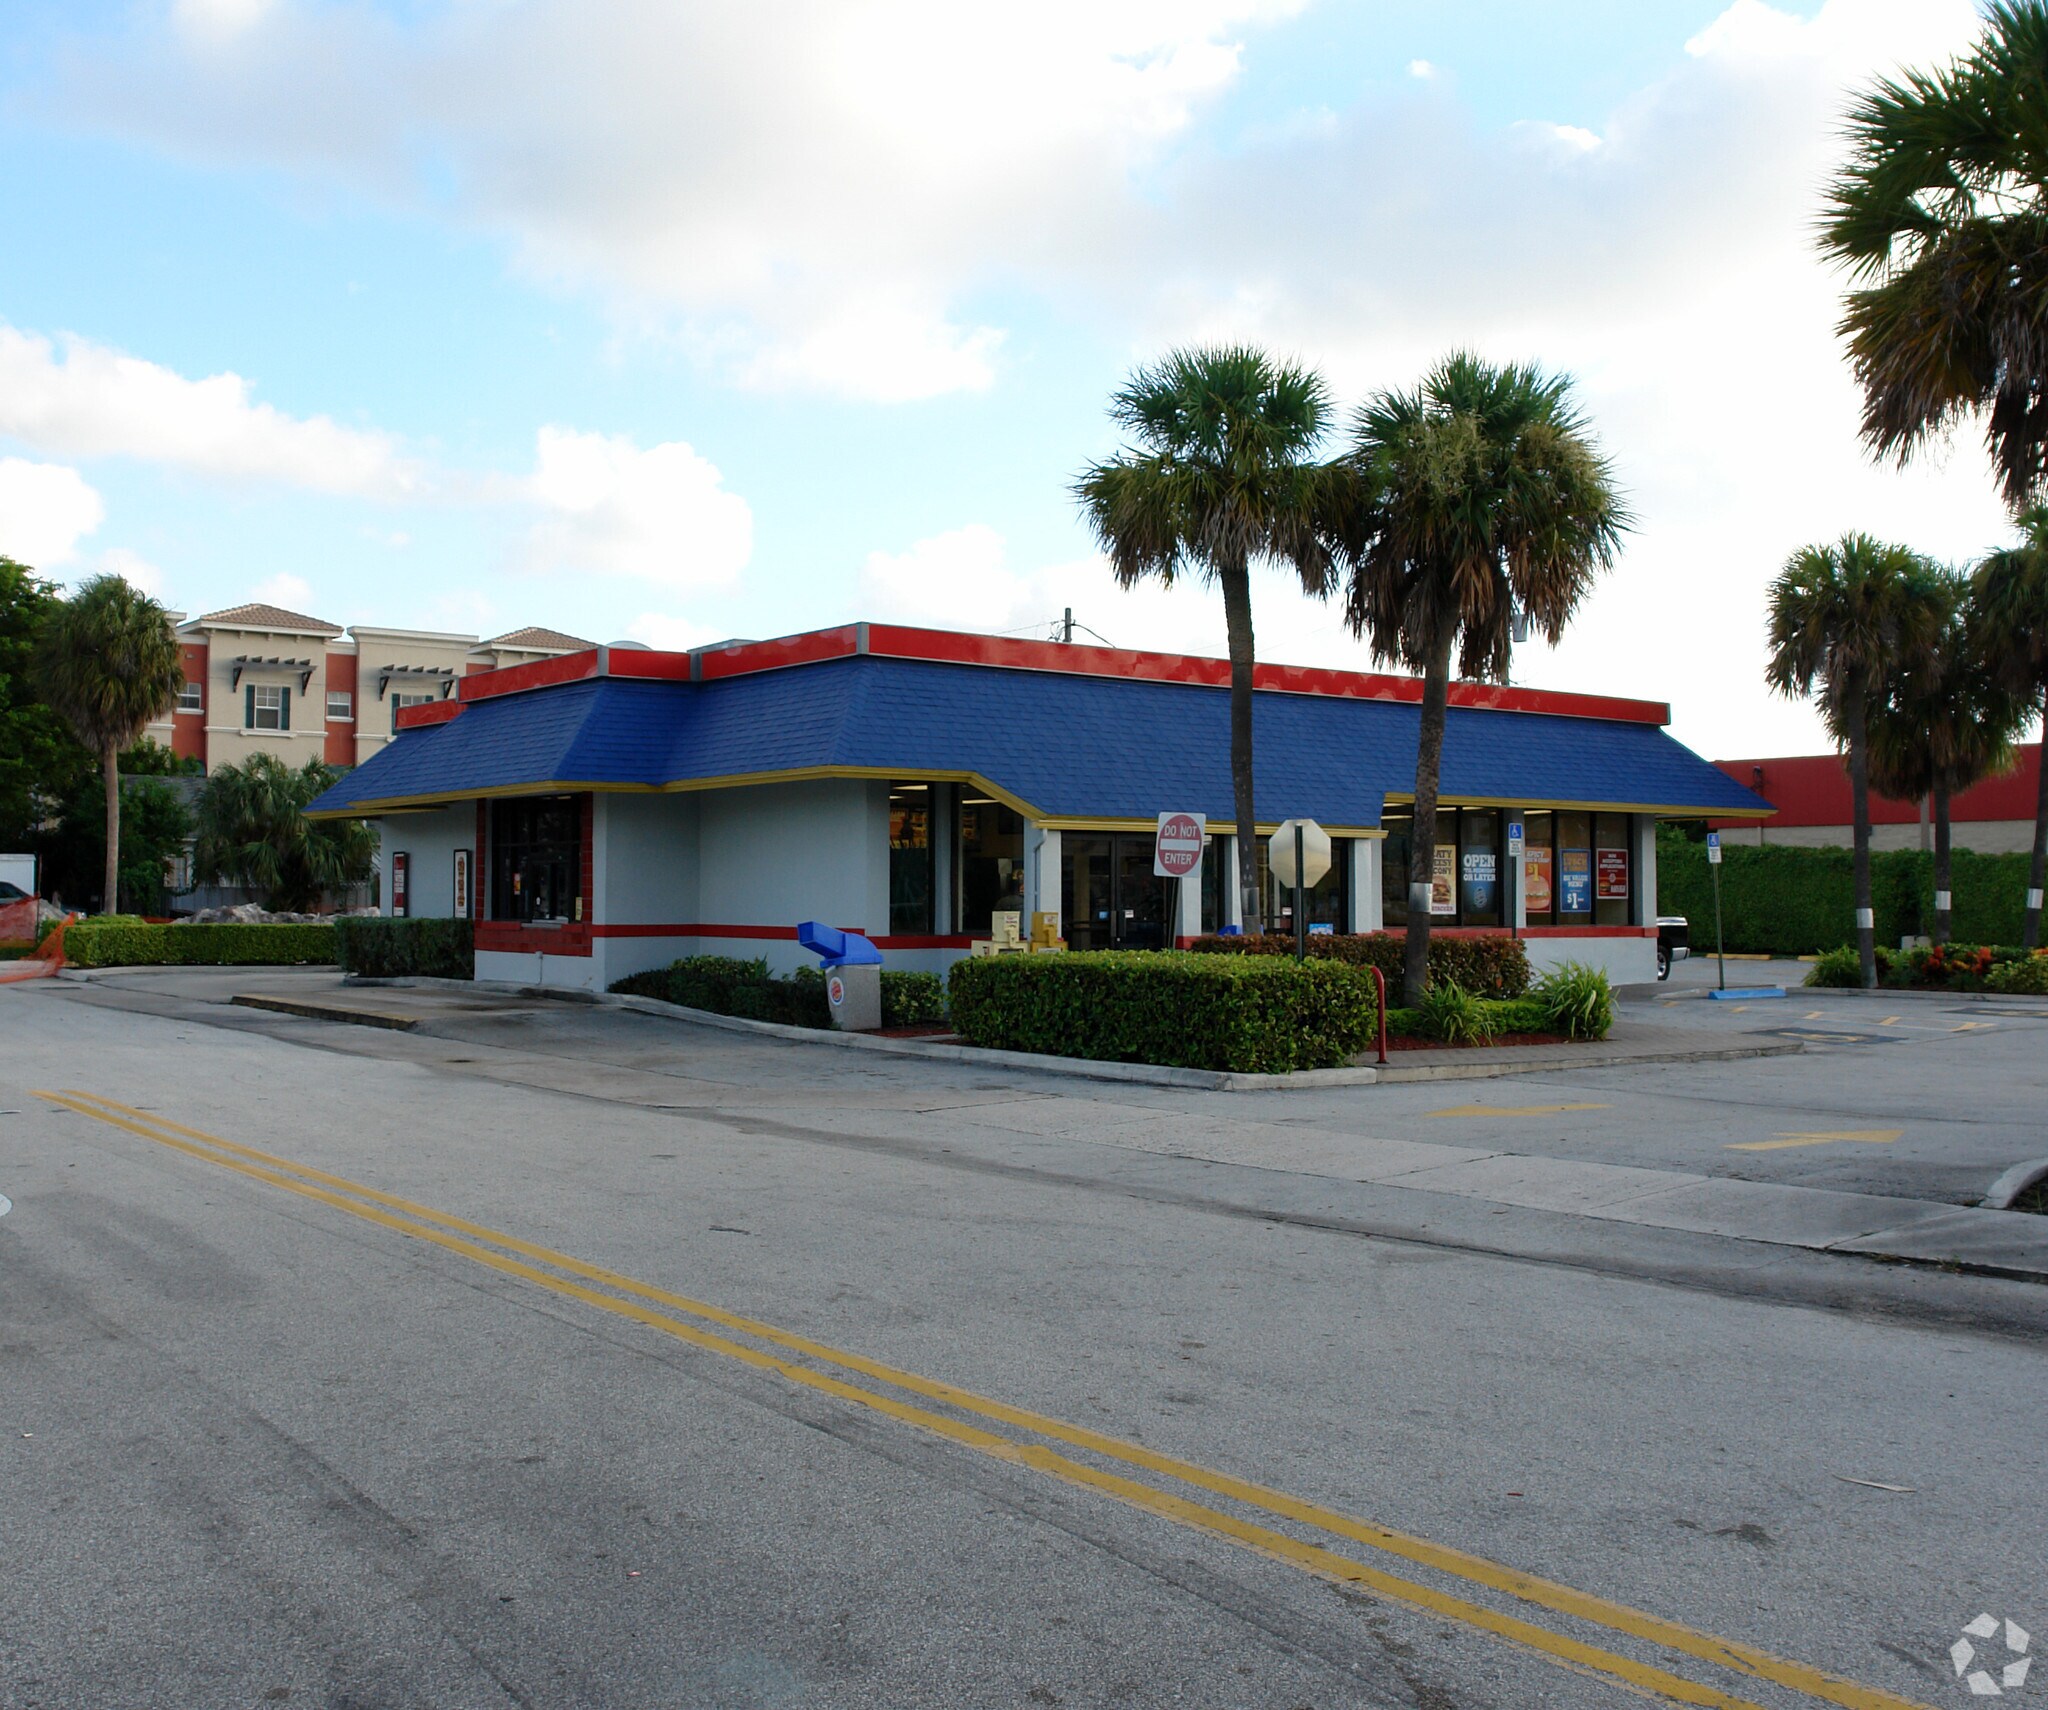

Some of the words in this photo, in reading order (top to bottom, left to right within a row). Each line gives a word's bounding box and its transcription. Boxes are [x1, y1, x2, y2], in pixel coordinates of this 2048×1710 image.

[1164, 825, 1177, 837] DO
[1180, 825, 1198, 838] NOT
[1164, 853, 1192, 865] ENTER
[1463, 854, 1496, 868] OPEN
[1463, 874, 1473, 882] OR
[1474, 874, 1496, 882] LATER
[1567, 892, 1578, 909] $1
